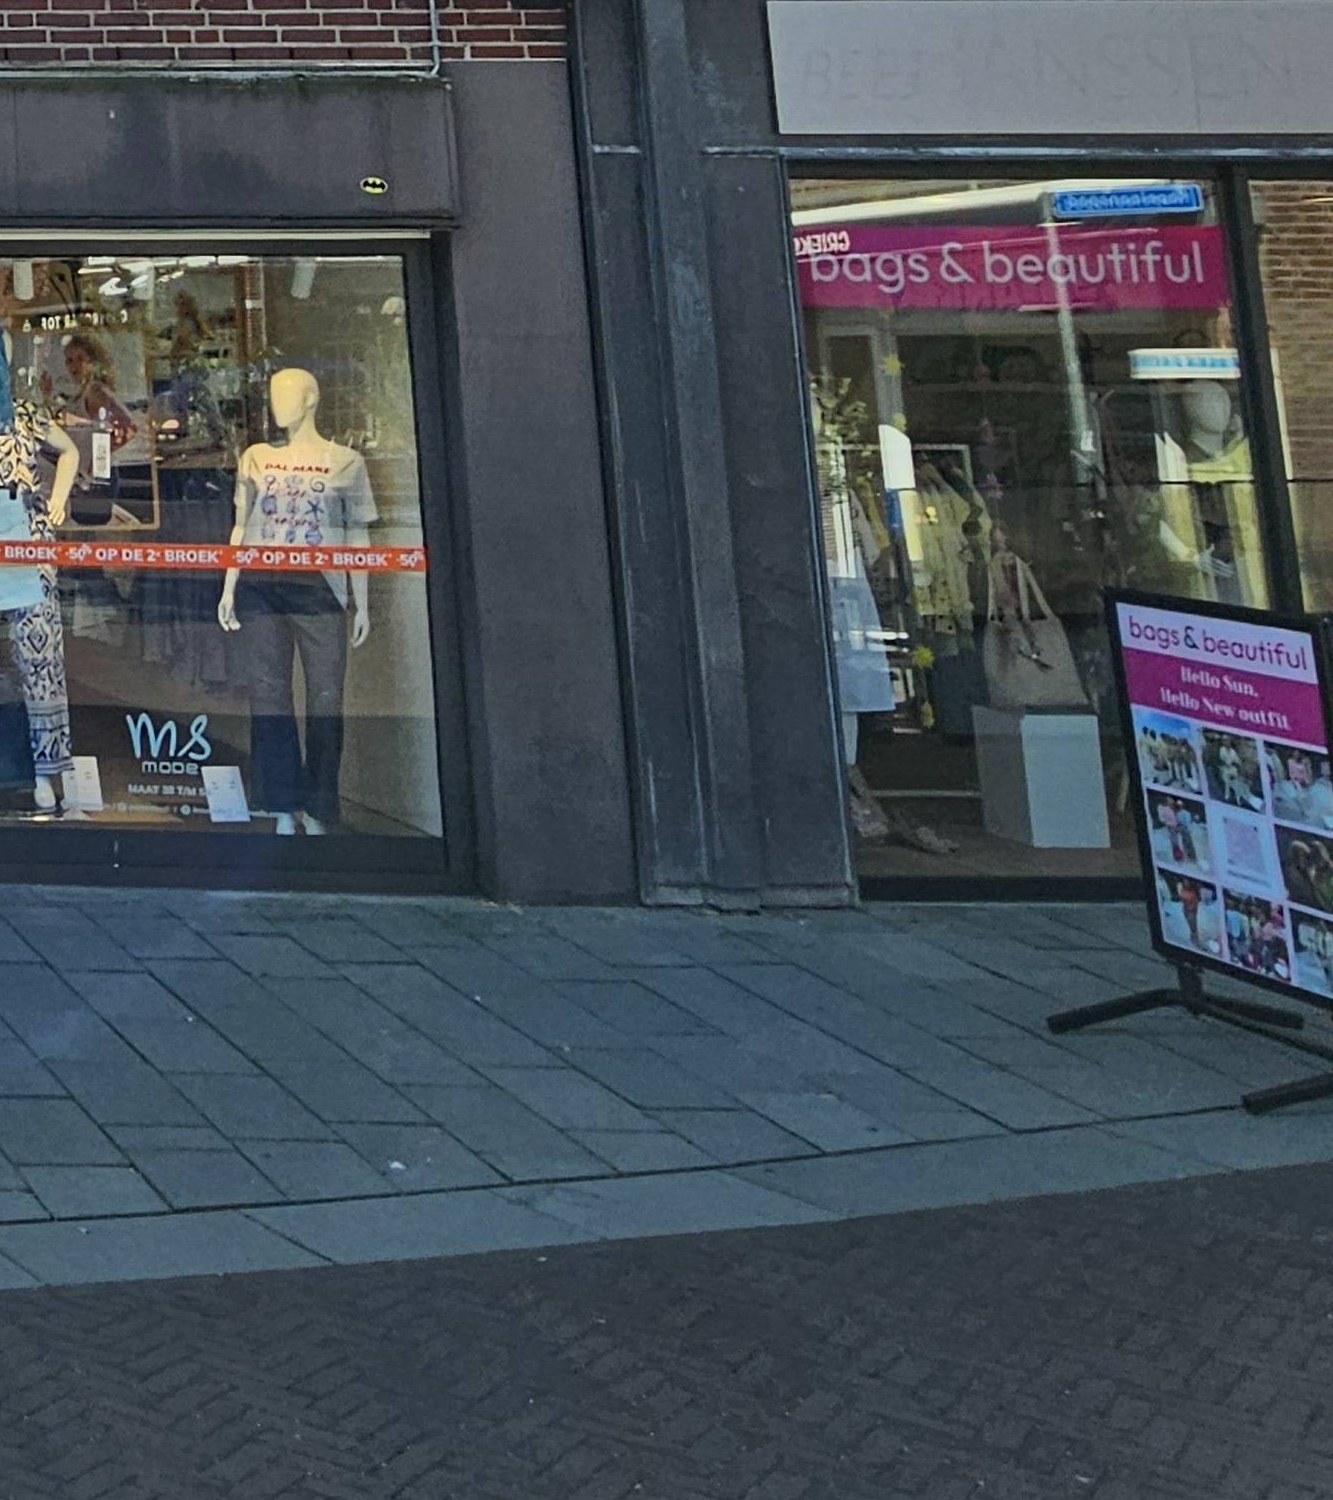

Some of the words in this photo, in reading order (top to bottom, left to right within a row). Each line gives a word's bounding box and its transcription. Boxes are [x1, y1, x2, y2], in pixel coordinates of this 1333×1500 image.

[810, 242, 931, 294] bags
[939, 241, 974, 283] &
[983, 240, 1204, 284] beautiful
[95, 546, 118, 560] OP
[121, 547, 142, 561] DE
[262, 551, 286, 565] OP
[289, 552, 311, 565] DE
[1129, 615, 1180, 649] bags
[1183, 625, 1200, 650] &
[1202, 629, 1308, 670] beautiful
[1181, 665, 1221, 689] Hello
[1160, 687, 1200, 711] Hello
[1202, 697, 1236, 717] New
[1238, 708, 1291, 731] outfit
